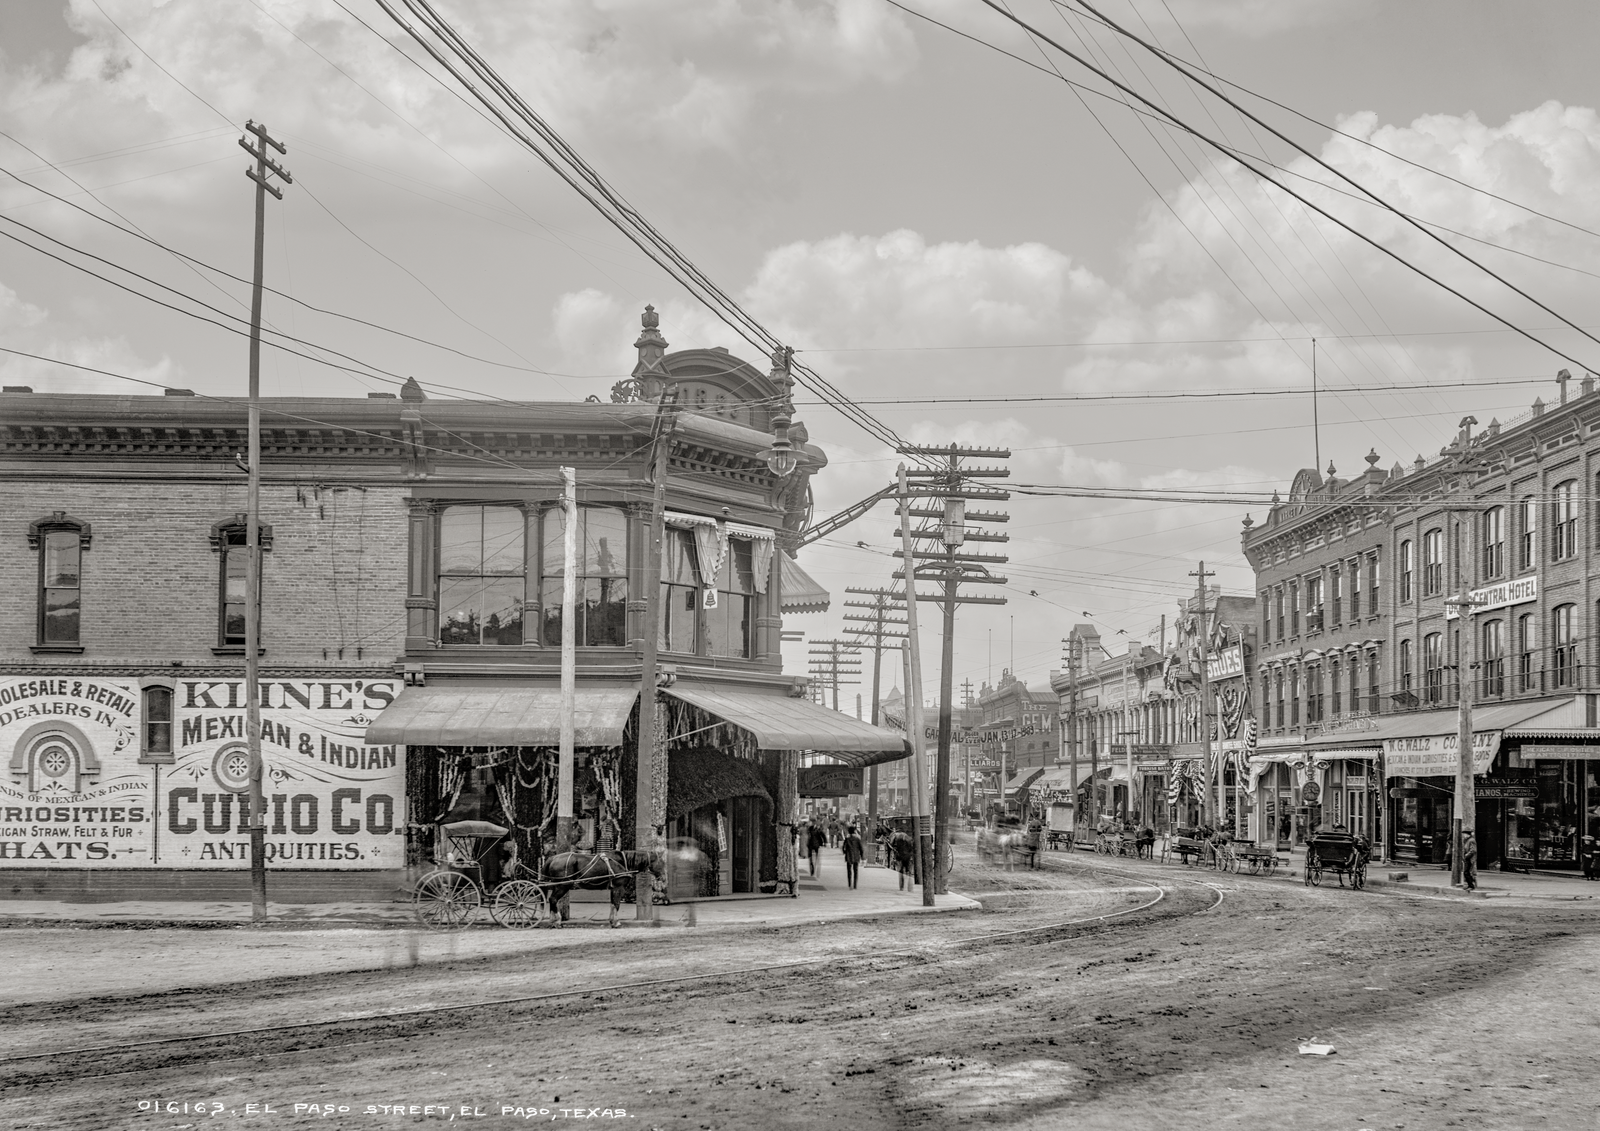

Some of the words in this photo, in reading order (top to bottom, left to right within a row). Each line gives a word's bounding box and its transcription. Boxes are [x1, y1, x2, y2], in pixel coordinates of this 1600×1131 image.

[1474, 587, 1507, 607] CENTRAL
[1509, 580, 1535, 600] HOTEL
[1207, 650, 1241, 678] SHOES
[0, 680, 68, 706] OLESALE
[71, 681, 82, 697] &
[85, 684, 136, 718] RETAIL
[181, 680, 395, 710] KLINE'S
[0, 702, 92, 727] DEALERS
[95, 710, 117, 728] IN
[1022, 701, 1047, 711] THE
[1023, 713, 1051, 733] GEM
[182, 714, 291, 748] MEXIAN
[298, 732, 315, 758] &
[320, 734, 396, 770] INDIAN
[1111, 746, 1139, 754] FELDAN.
[1443, 734, 1495, 749] COANY
[1387, 755, 1403, 765] EXICAN
[28, 794, 42, 803] OF
[45, 791, 97, 804] MEXICAN
[99, 789, 107, 797] &
[108, 782, 149, 794] INDIAN
[1475, 788, 1503, 798] IANOS,
[0, 806, 150, 823] RIOSITIES.
[331, 787, 402, 835] CO.
[0, 827, 27, 837] ICAN
[31, 825, 71, 838] STRAW,
[74, 825, 97, 837] FELT
[101, 828, 108, 838] &
[113, 826, 133, 838] FUR
[0, 840, 117, 860] HATS.
[200, 842, 365, 863] ANTQUITIES.
